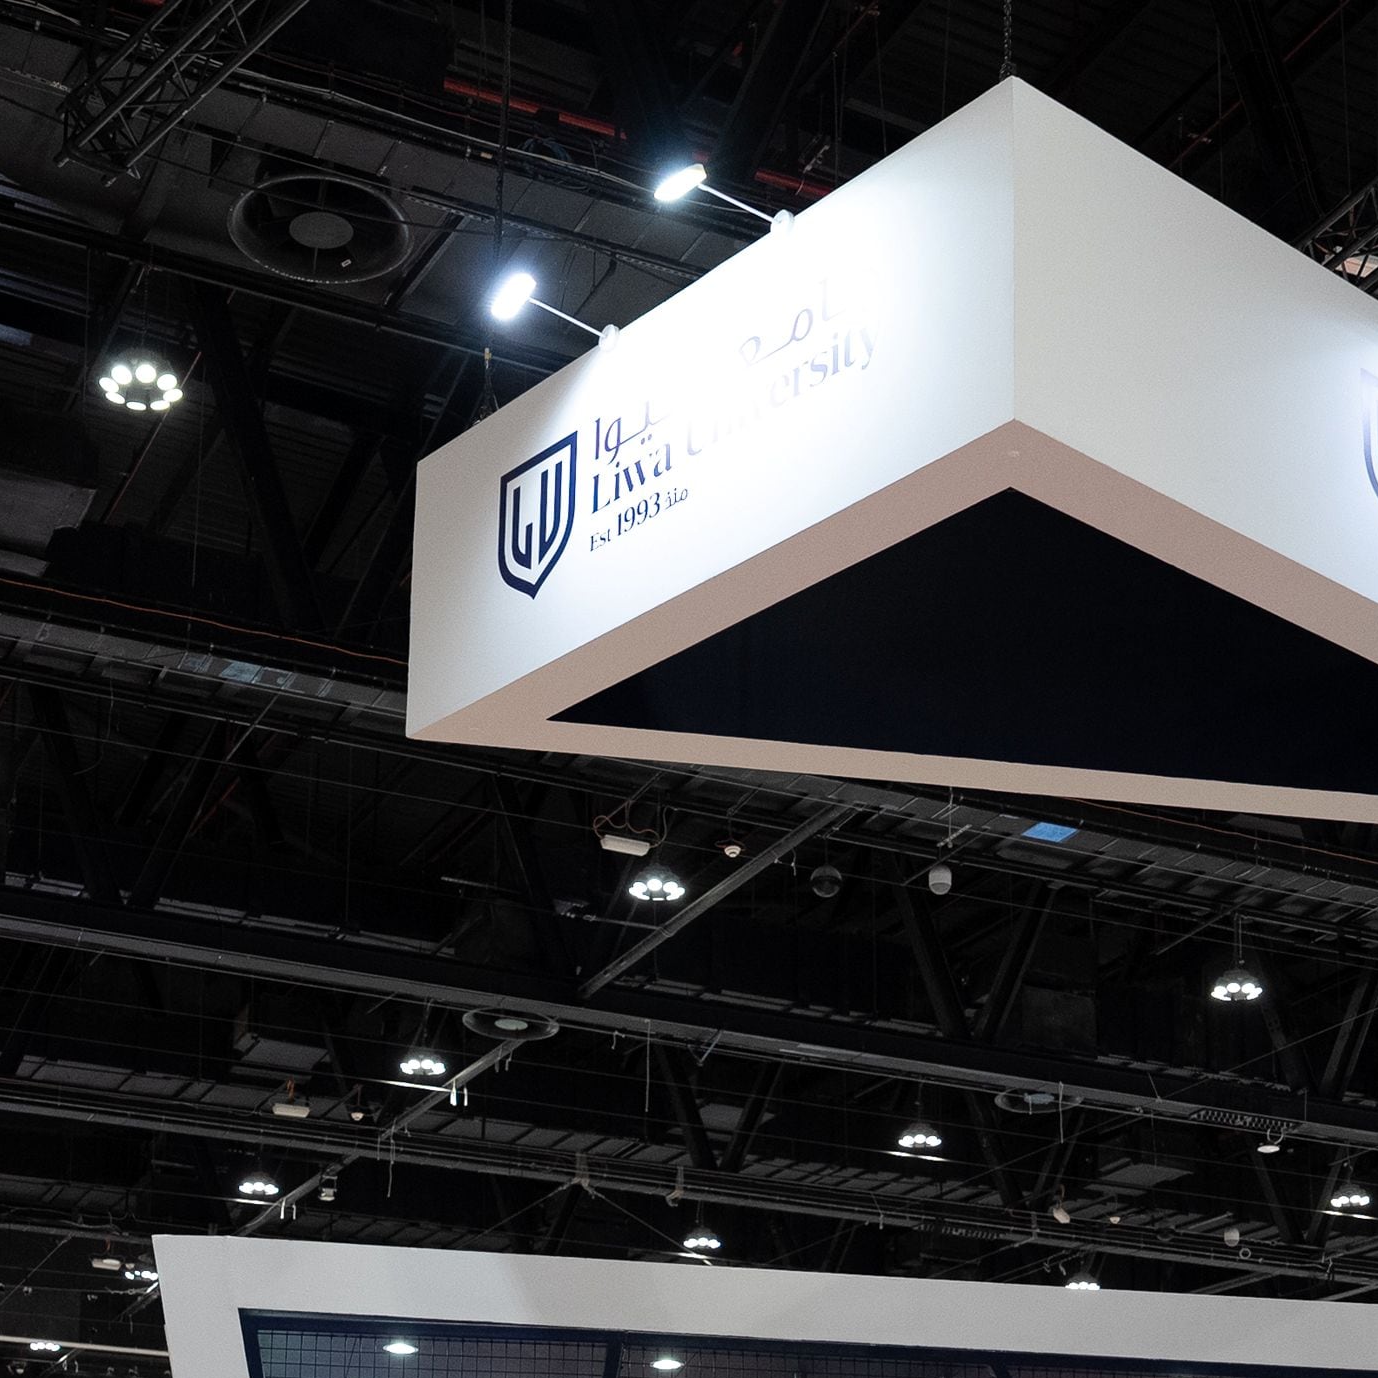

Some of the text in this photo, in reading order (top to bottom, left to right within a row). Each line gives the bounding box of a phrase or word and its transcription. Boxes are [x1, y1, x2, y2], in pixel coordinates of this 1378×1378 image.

[590, 441, 673, 516] Liwa
[589, 528, 613, 552] Est
[616, 492, 661, 537] 1993
